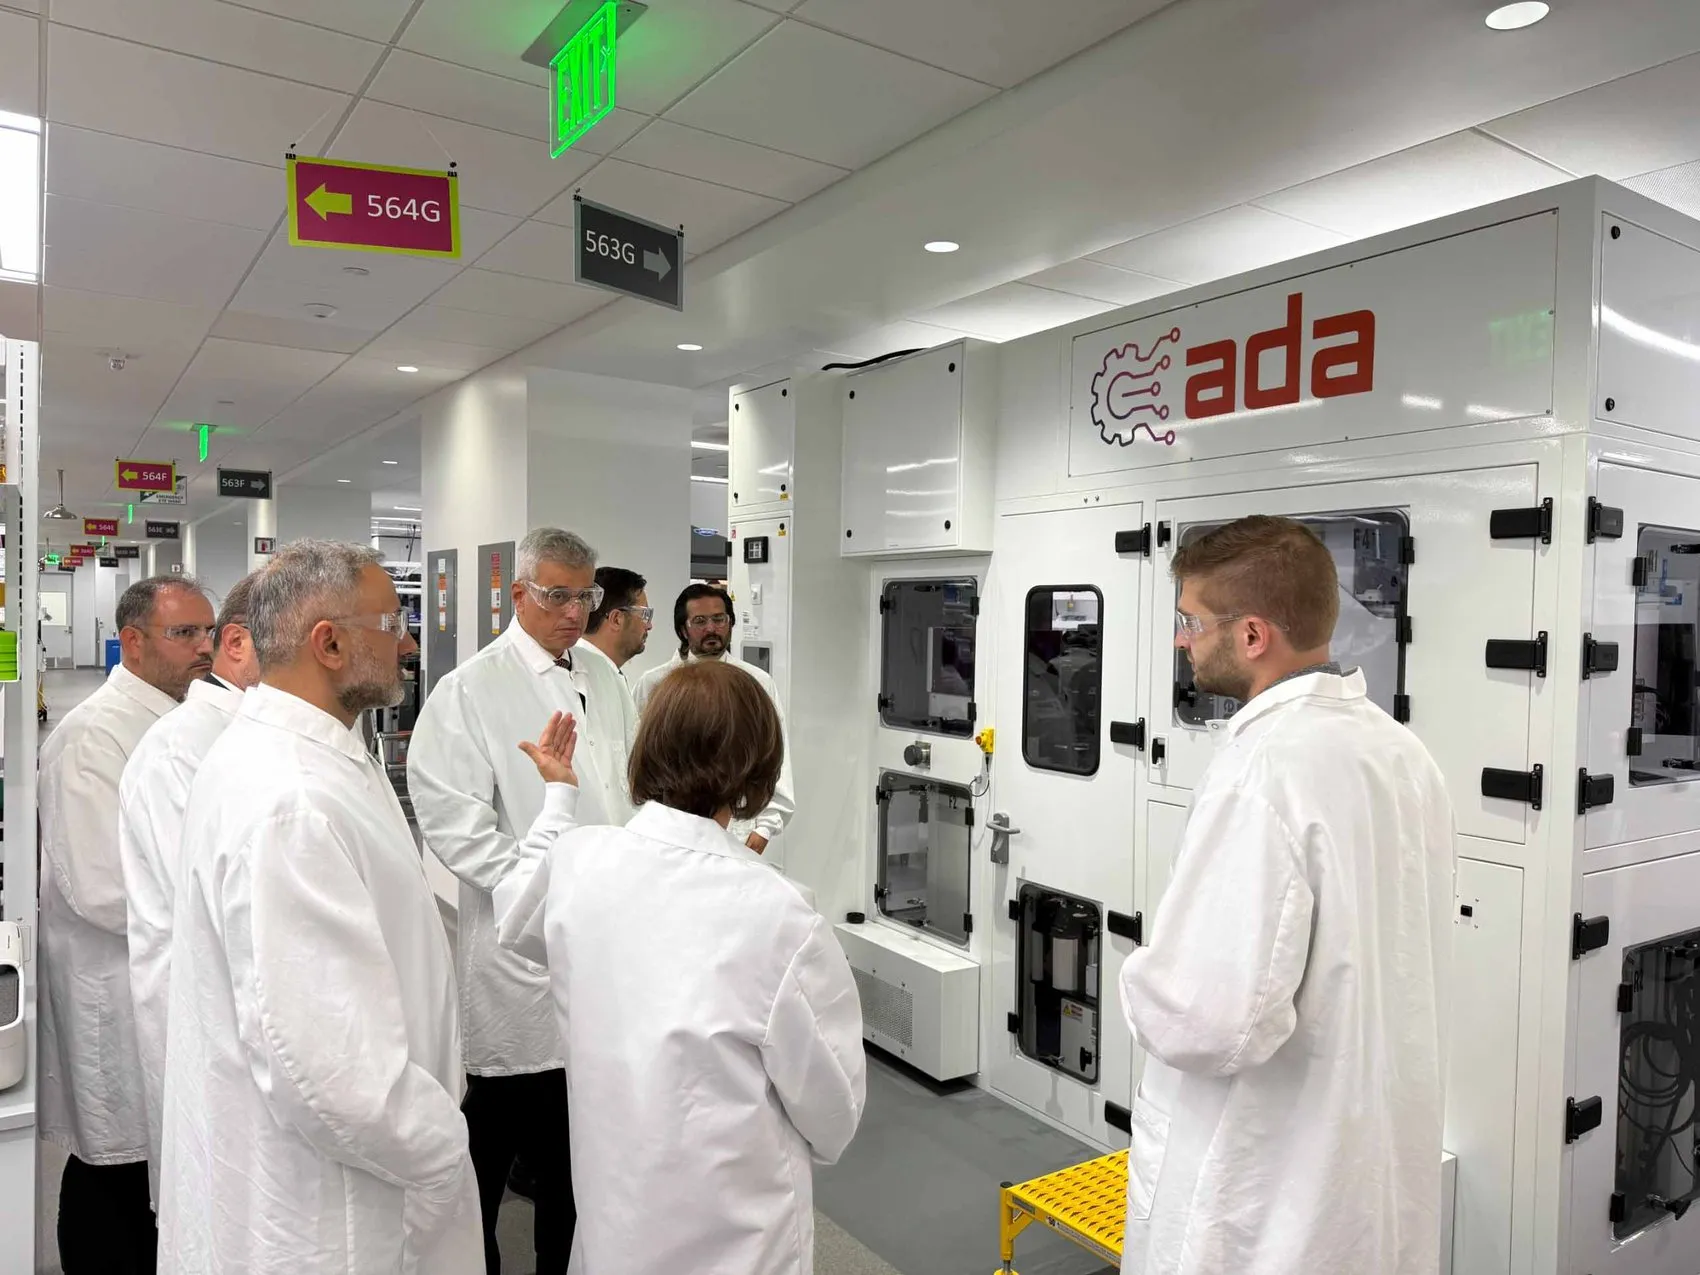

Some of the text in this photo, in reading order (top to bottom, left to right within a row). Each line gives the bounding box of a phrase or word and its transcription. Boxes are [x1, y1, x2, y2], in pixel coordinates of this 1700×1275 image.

[557, 17, 605, 141] EXIT
[367, 194, 441, 223] 564G
[585, 229, 635, 265] 563G
[1185, 292, 1375, 420] ada
[142, 471, 168, 481] 564F
[221, 478, 245, 488] 563F
[1353, 528, 1370, 550] F4
